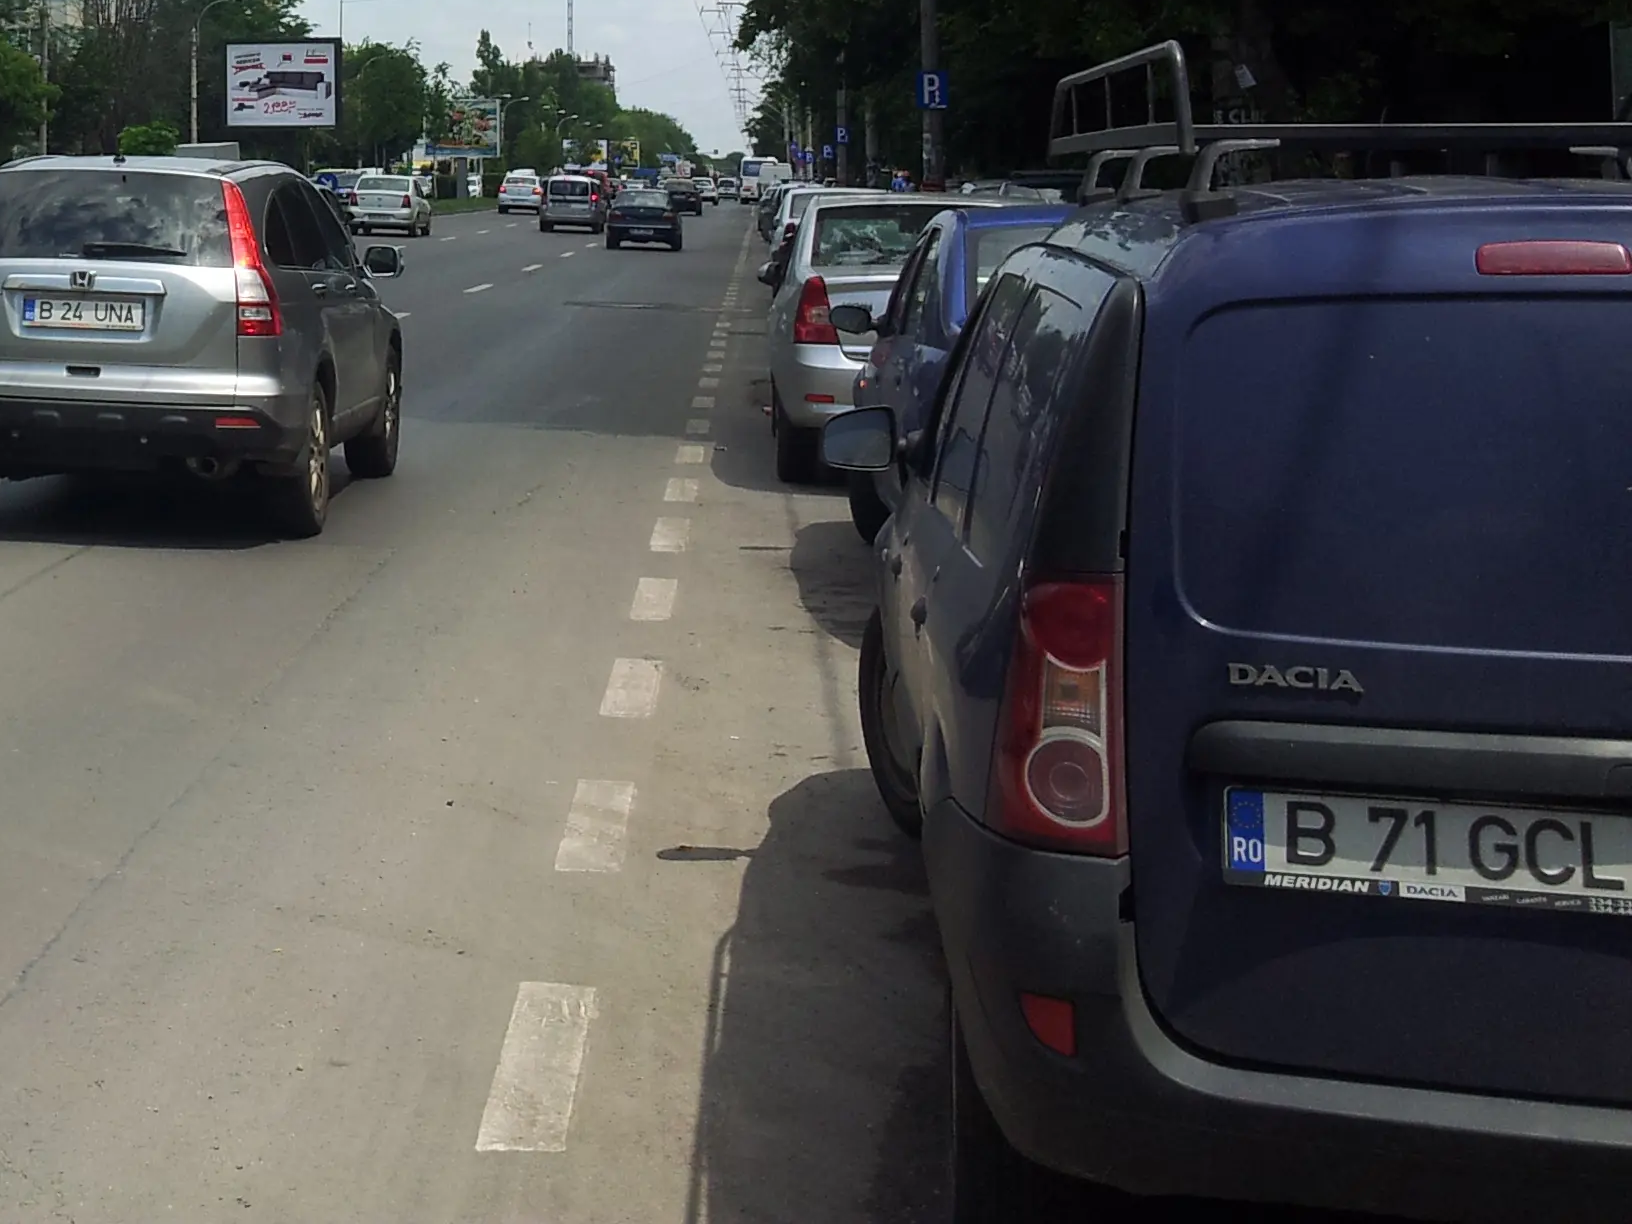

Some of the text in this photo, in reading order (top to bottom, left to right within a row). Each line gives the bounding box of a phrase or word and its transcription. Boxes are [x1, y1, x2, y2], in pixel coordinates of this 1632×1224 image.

[922, 73, 940, 105] P
[39, 301, 53, 320] B
[60, 302, 83, 321] 24
[94, 302, 135, 324] UNA
[1228, 662, 1365, 694] DACIA
[1232, 835, 1262, 864] RO
[1285, 800, 1626, 892] B 71 GCL
[1264, 874, 1370, 893] MERIDIAN
[1406, 885, 1459, 898] DACIA
